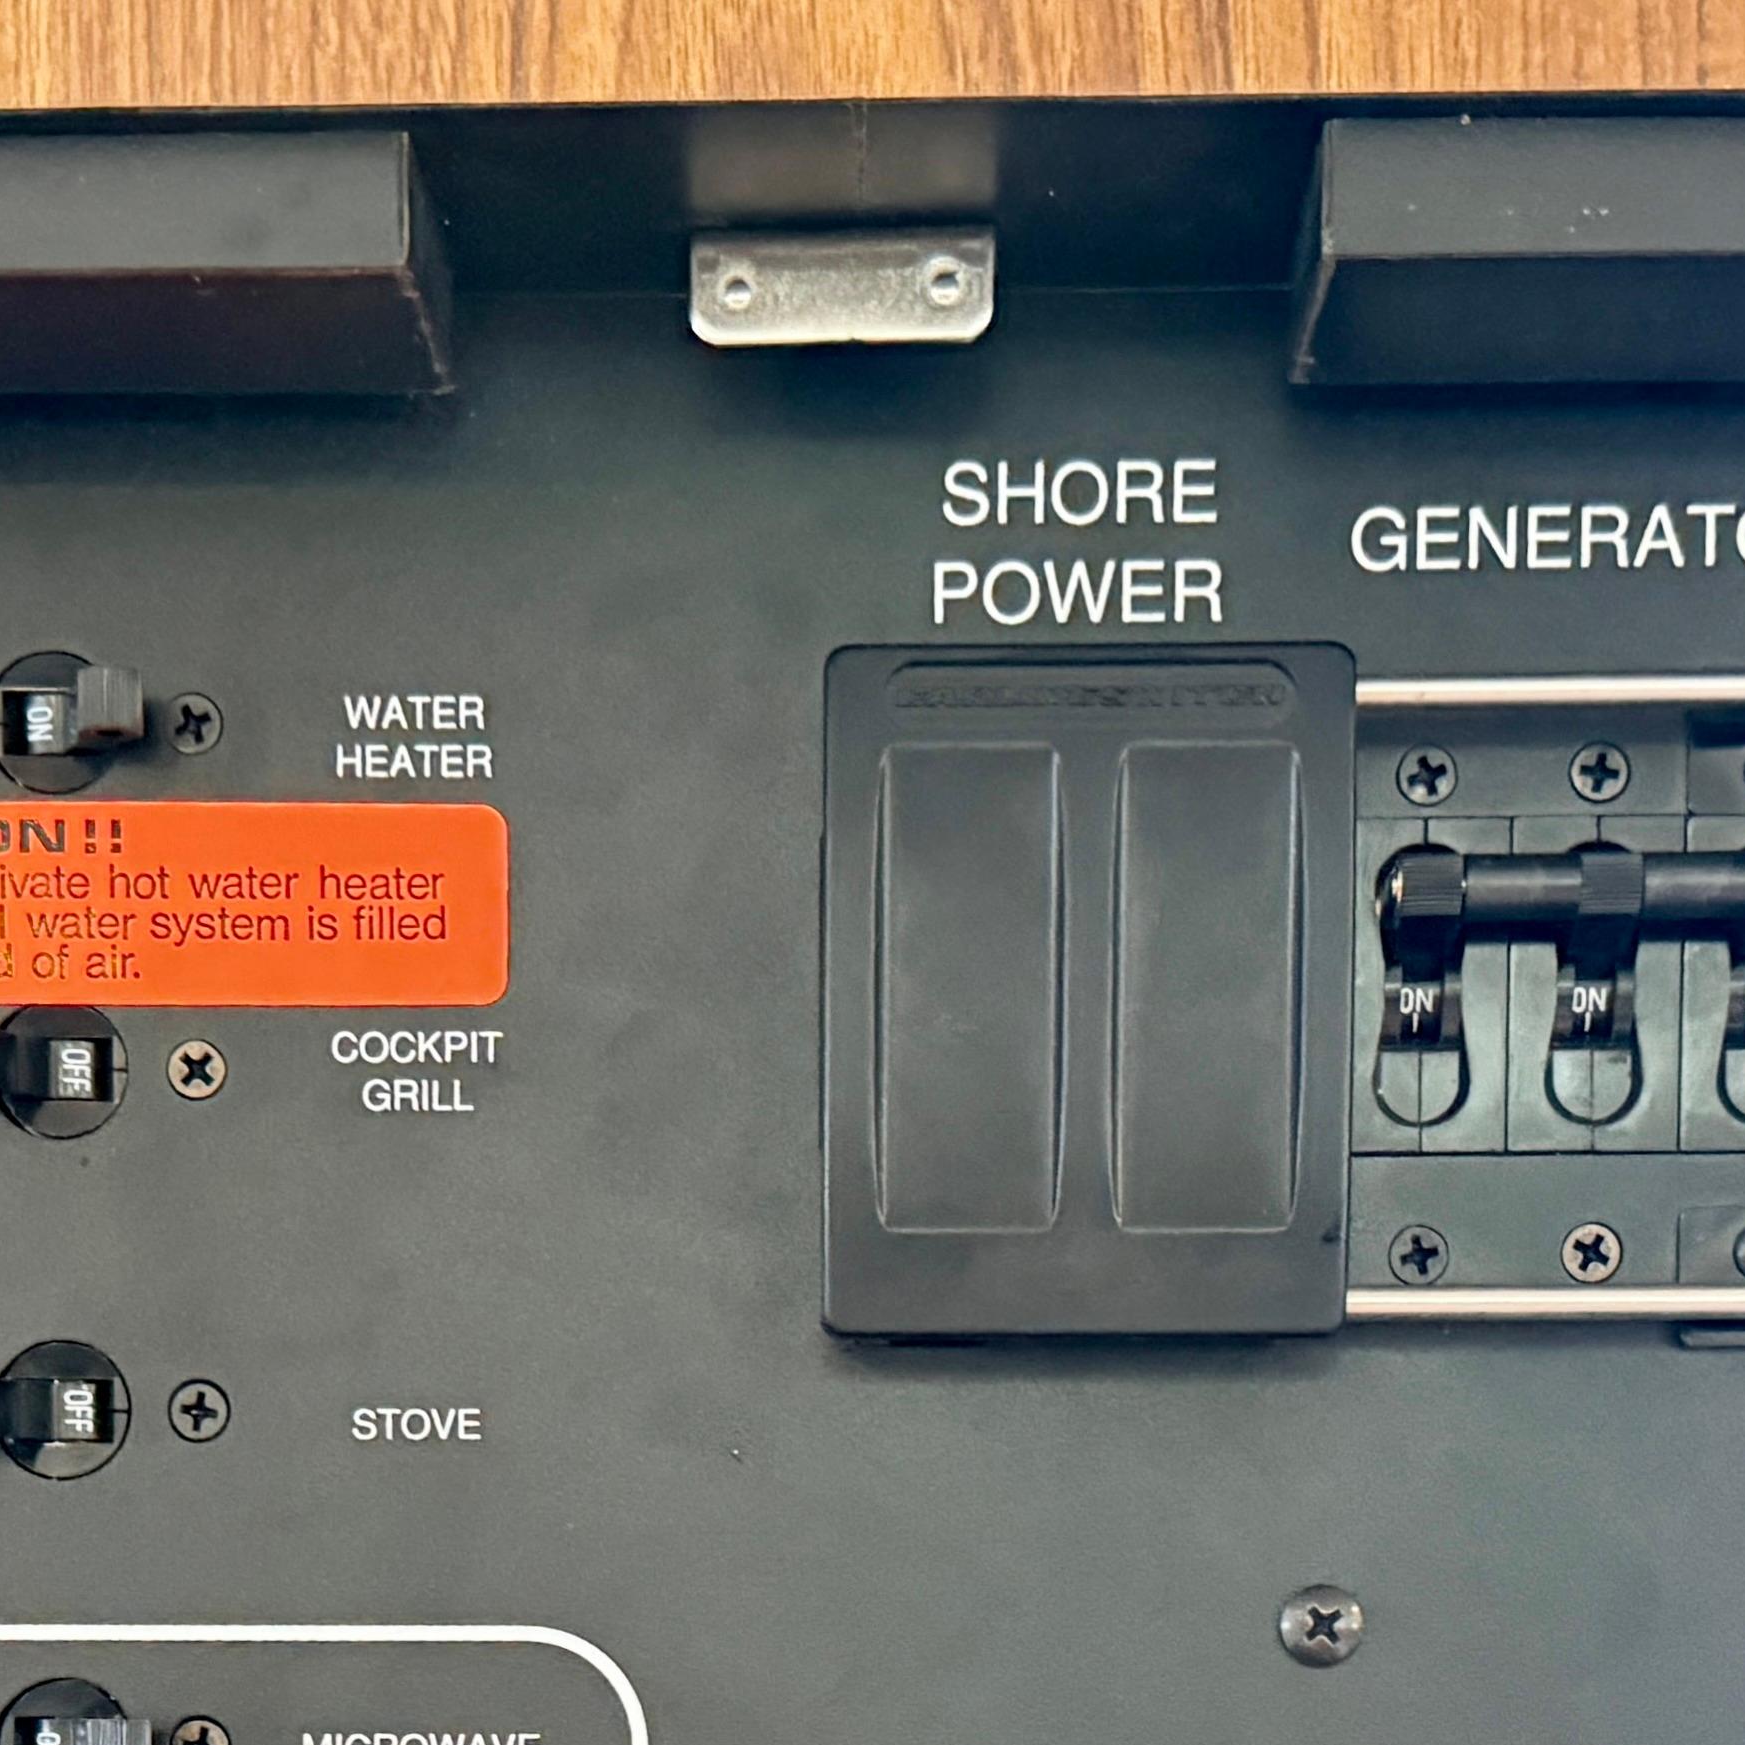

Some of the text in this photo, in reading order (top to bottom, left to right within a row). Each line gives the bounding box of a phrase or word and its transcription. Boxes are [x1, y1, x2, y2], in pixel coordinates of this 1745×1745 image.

[942, 458, 1218, 527] SHORE
[933, 559, 1223, 626] POWER
[25, 704, 54, 744] ON
[343, 694, 485, 730] WATER
[336, 743, 493, 779] HEATER
[109, 864, 170, 900] hot
[188, 868, 300, 901] water
[318, 865, 445, 901] heater
[26, 910, 137, 941] water
[150, 911, 289, 949] system
[309, 907, 337, 941] is
[352, 906, 445, 941] filled
[33, 946, 70, 979] of
[86, 949, 140, 980] air.
[331, 1030, 504, 1064] COCKPIT
[60, 1048, 90, 1095] OFF
[362, 1078, 475, 1112] GRILL
[64, 1390, 93, 1433] OFF
[351, 1407, 482, 1441] STOVE
